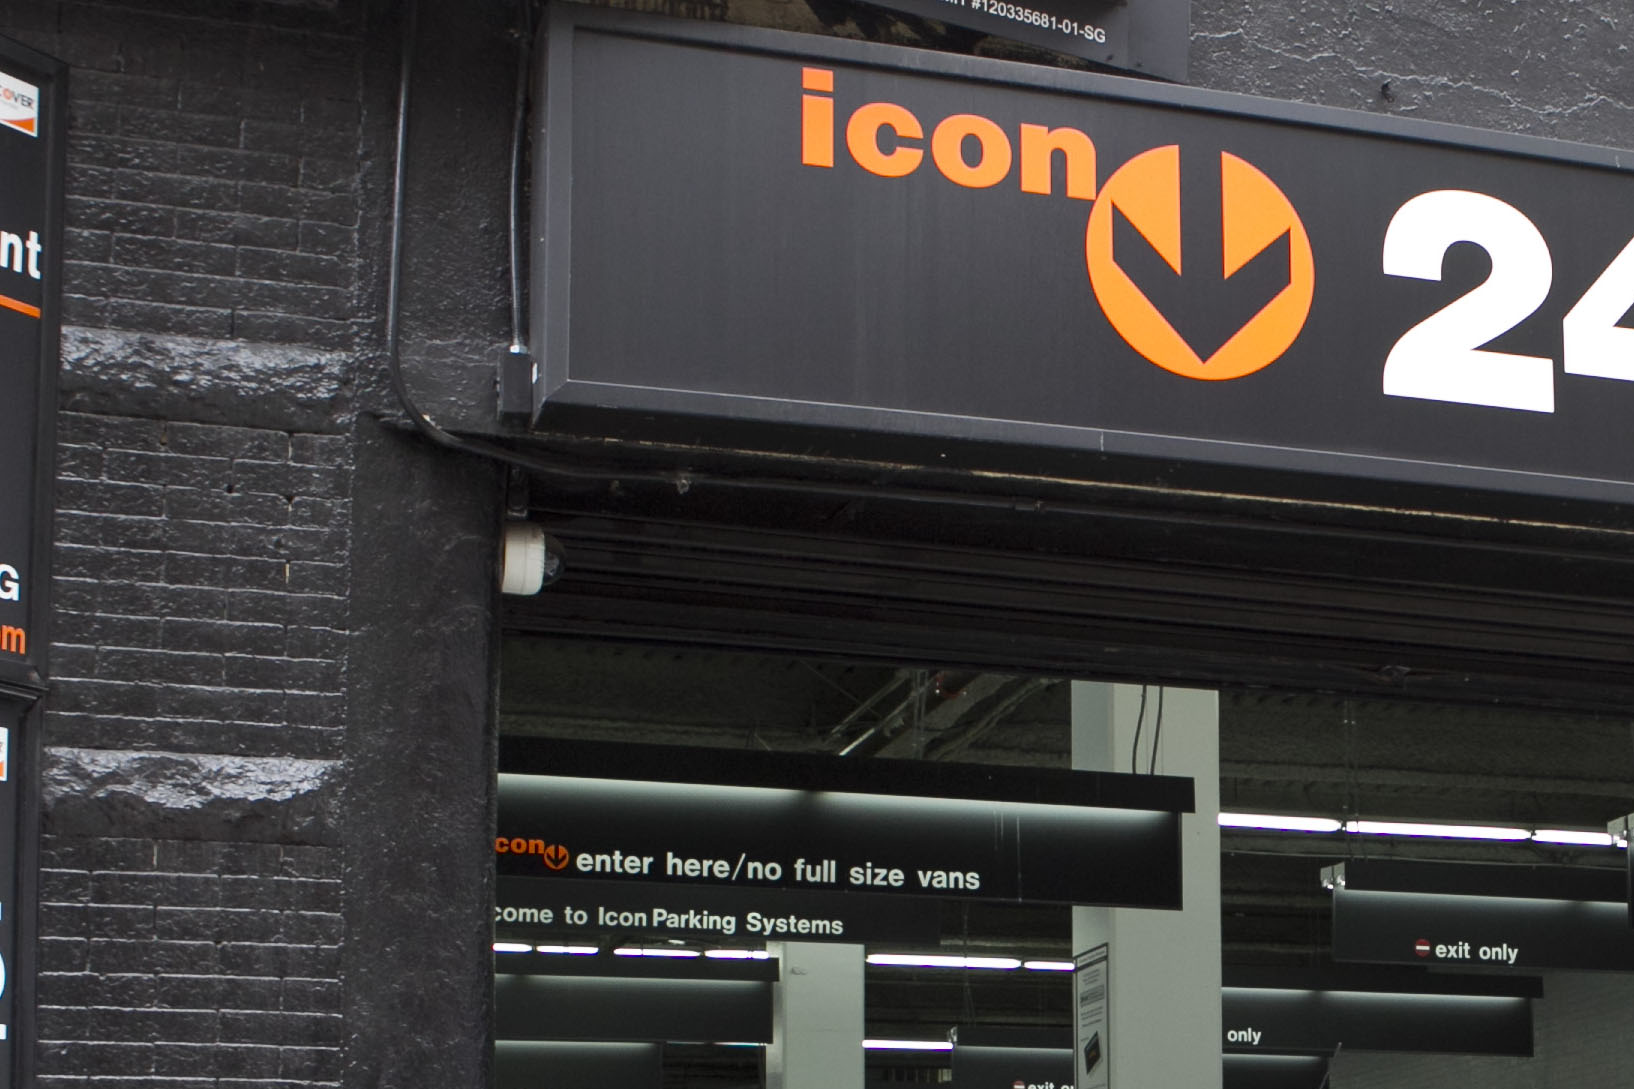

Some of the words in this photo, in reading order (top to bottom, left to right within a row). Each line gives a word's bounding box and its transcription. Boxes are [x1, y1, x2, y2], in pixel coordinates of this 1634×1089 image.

[971, 0, 1106, 44] #120335681-01-SG
[800, 67, 1097, 202] icon
[576, 850, 654, 874] enter
[666, 851, 782, 881] here/no
[793, 858, 836, 883] full
[849, 862, 905, 886] size
[917, 870, 980, 890] vans
[564, 906, 588, 925] to
[598, 906, 647, 927] Icon
[652, 908, 736, 935] Parking
[746, 911, 844, 935] Systems
[1435, 941, 1471, 960] exit
[1479, 943, 1519, 963] only
[1227, 1027, 1262, 1045] only
